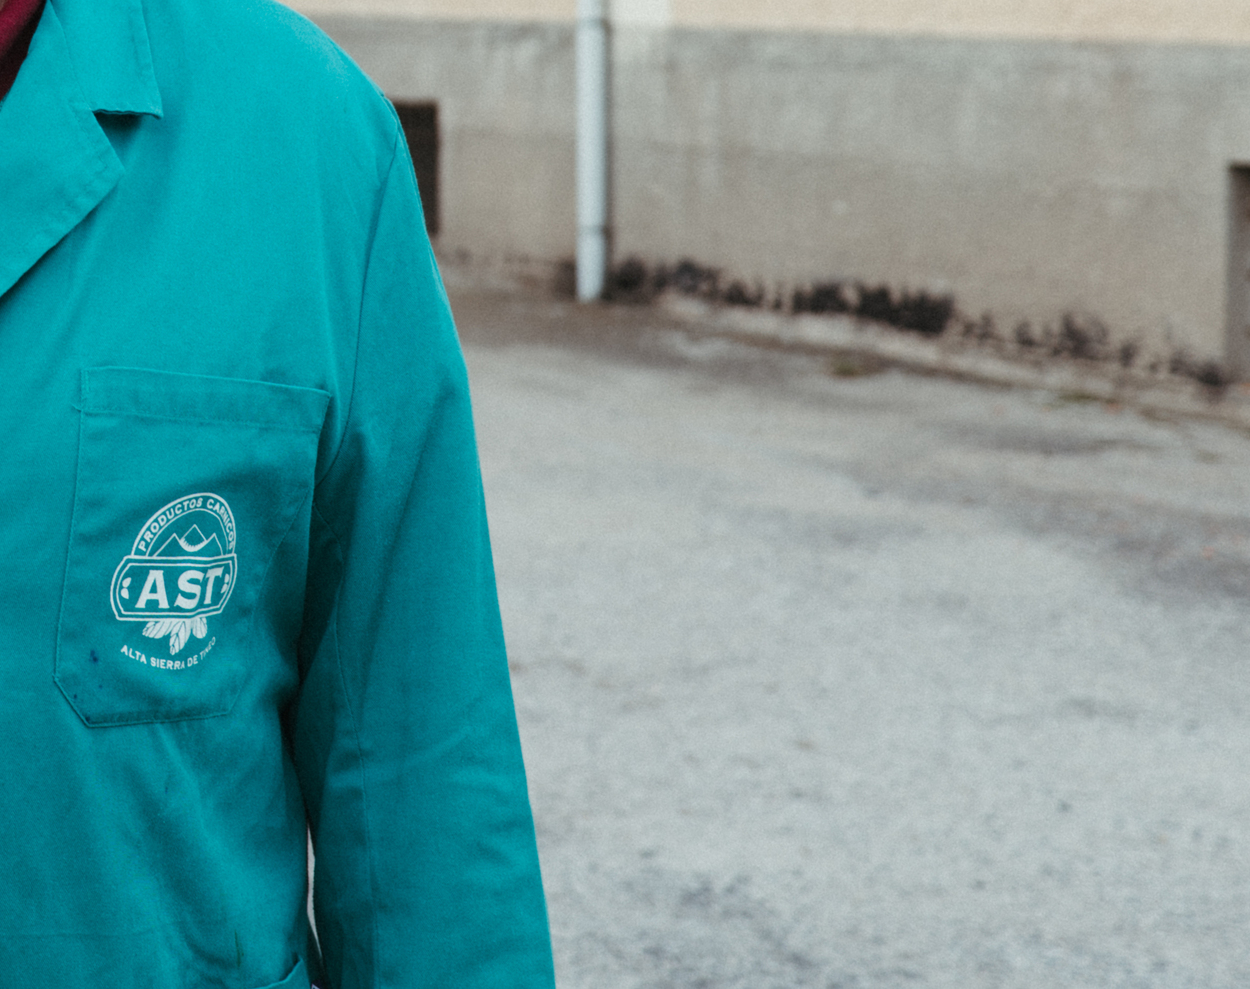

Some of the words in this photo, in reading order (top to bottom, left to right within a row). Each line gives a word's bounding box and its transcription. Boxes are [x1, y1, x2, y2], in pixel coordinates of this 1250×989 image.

[138, 497, 203, 552] PRODUCTOS
[135, 566, 224, 610] AST
[120, 644, 147, 665] ALTA
[150, 656, 185, 671] SIERRA
[187, 654, 199, 668] DE
